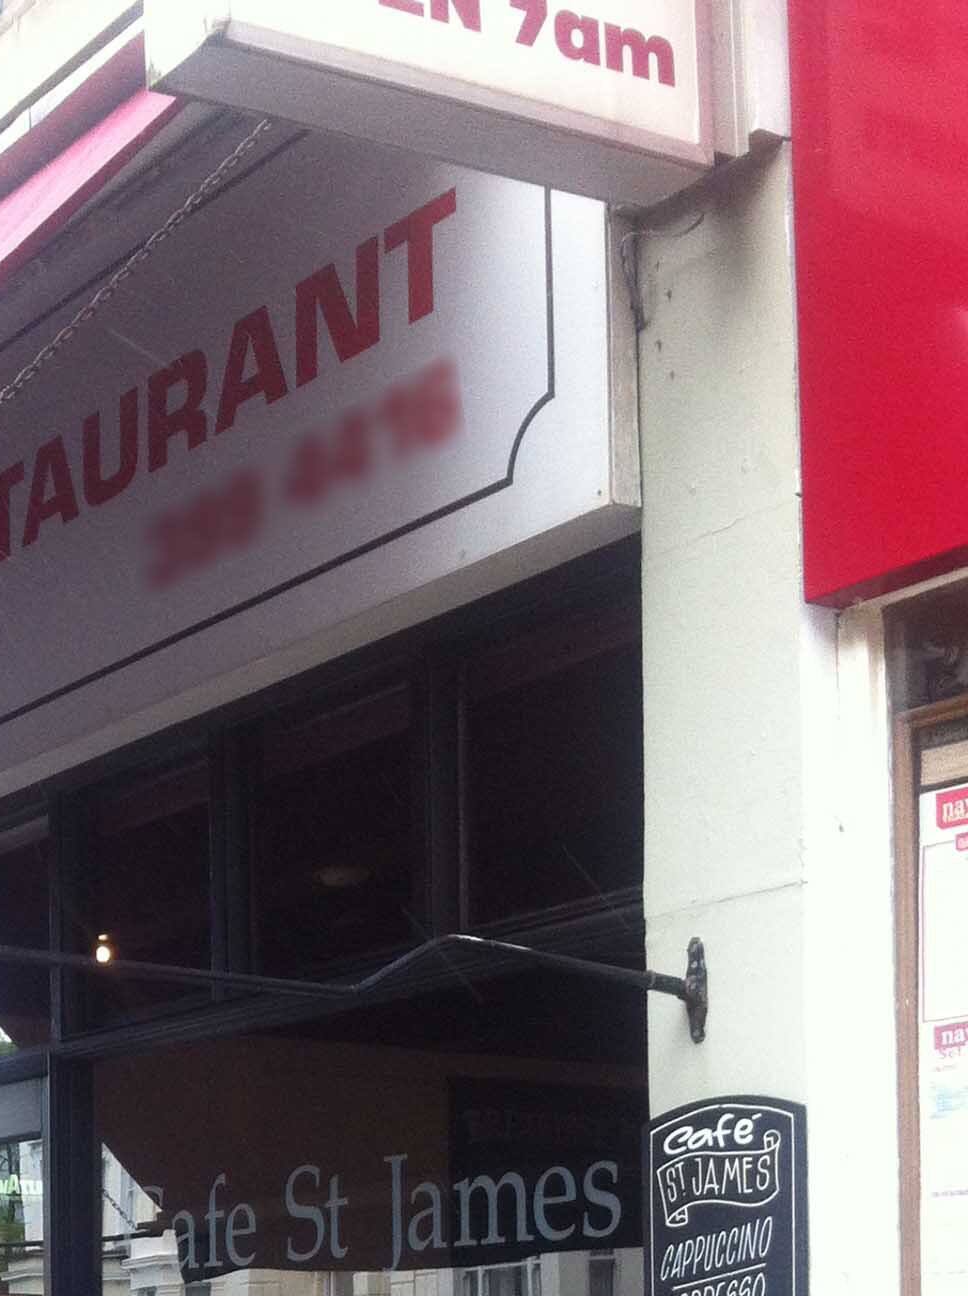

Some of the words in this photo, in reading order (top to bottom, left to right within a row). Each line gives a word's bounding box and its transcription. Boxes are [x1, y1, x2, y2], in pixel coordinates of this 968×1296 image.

[691, 1154, 771, 1197] JAMES
[284, 1164, 349, 1264] St
[384, 1152, 622, 1271] James
[660, 1216, 773, 1281] CAPPUCCINO
